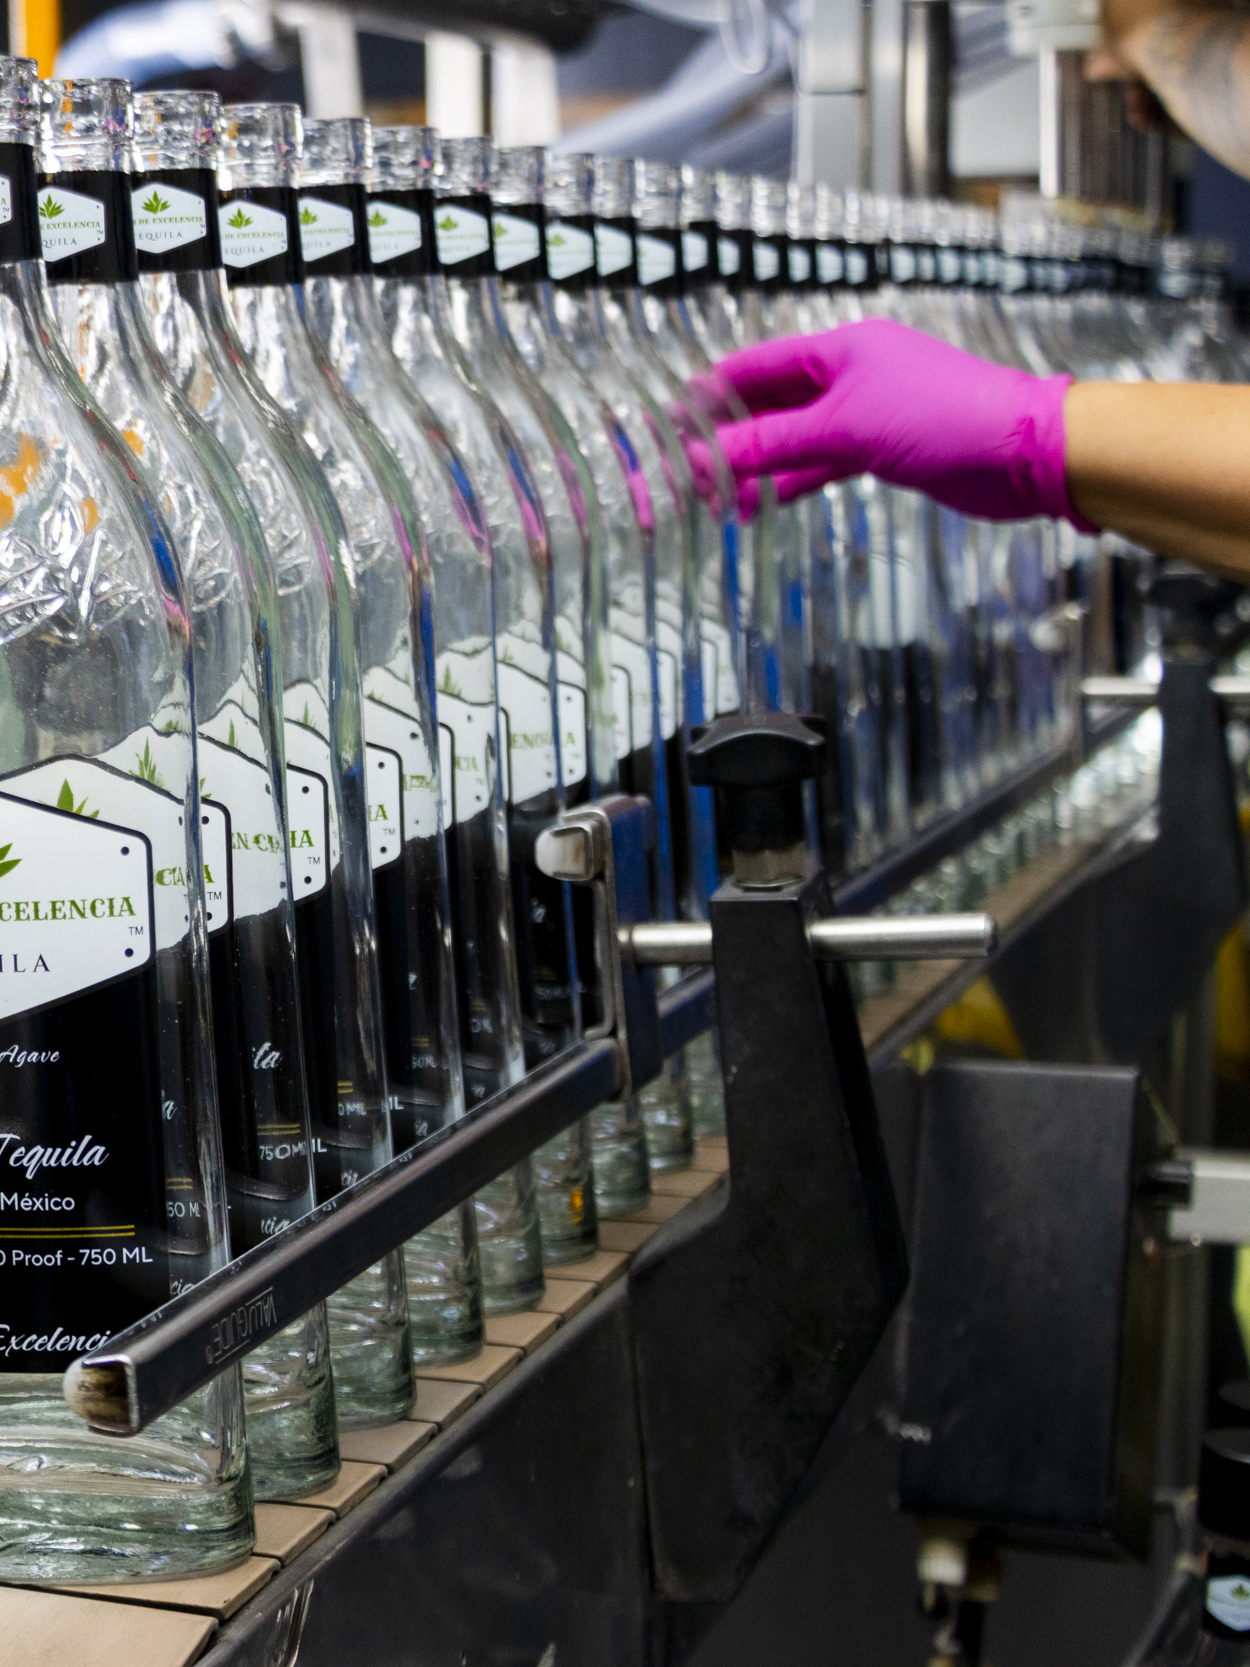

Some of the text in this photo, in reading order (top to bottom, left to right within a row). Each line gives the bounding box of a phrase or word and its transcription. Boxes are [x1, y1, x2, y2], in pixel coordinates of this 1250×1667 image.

[152, 216, 204, 224] EXCELENCIA
[47, 221, 102, 231] EXCELENCIA
[138, 231, 183, 241] EQUILA
[42, 238, 77, 249] QUILA
[224, 246, 265, 256] EQUILA
[207, 891, 221, 900] TM
[128, 926, 144, 936] TM
[0, 1191, 75, 1211] México
[12, 1248, 63, 1267] Proof
[79, 1247, 117, 1266] 750
[122, 1246, 154, 1264] ML
